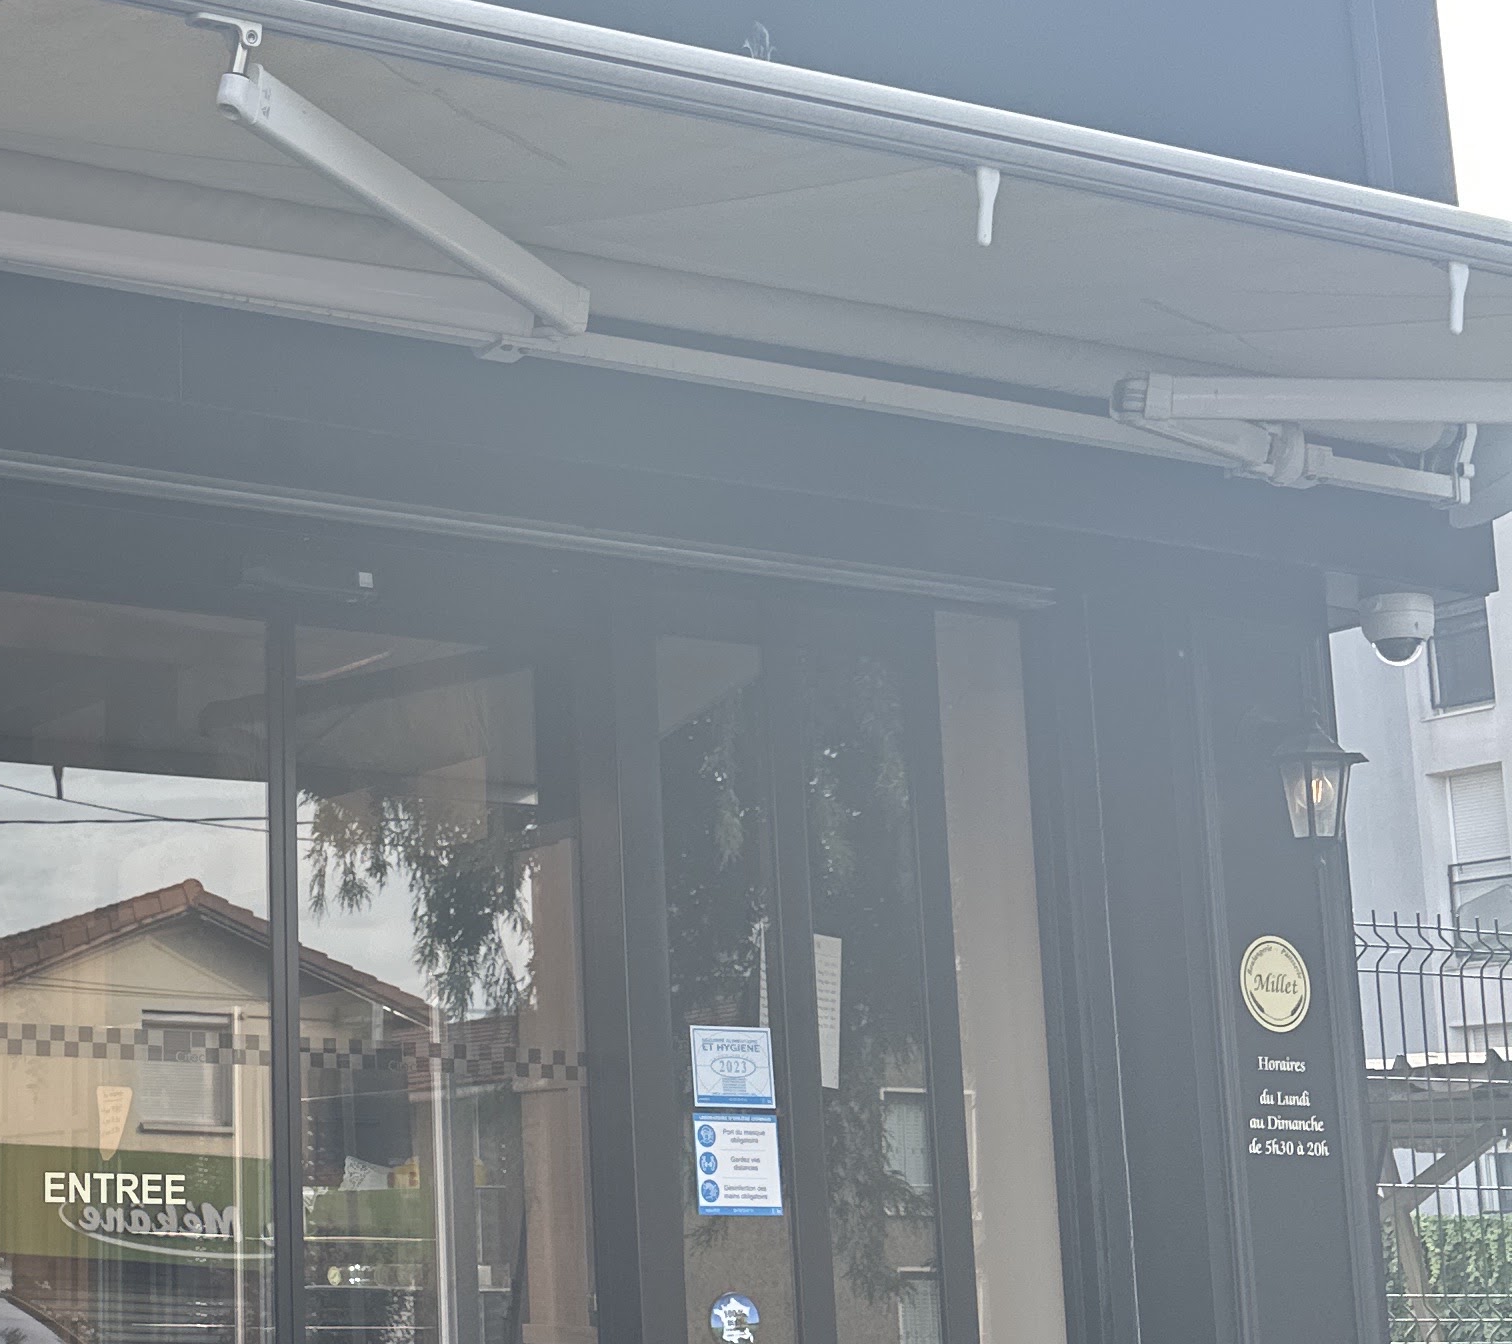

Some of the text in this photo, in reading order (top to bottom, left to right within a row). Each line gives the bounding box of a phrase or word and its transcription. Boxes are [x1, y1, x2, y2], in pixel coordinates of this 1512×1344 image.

[1254, 973, 1298, 994] Millet
[719, 1060, 747, 1074] 2023
[1257, 1056, 1306, 1072] Horaires
[1259, 1088, 1310, 1107] du Lundi
[1249, 1115, 1325, 1132] au Dimanche
[1248, 1137, 1330, 1156] de 5h30 à 20h
[44, 1172, 186, 1205] ENTREE
